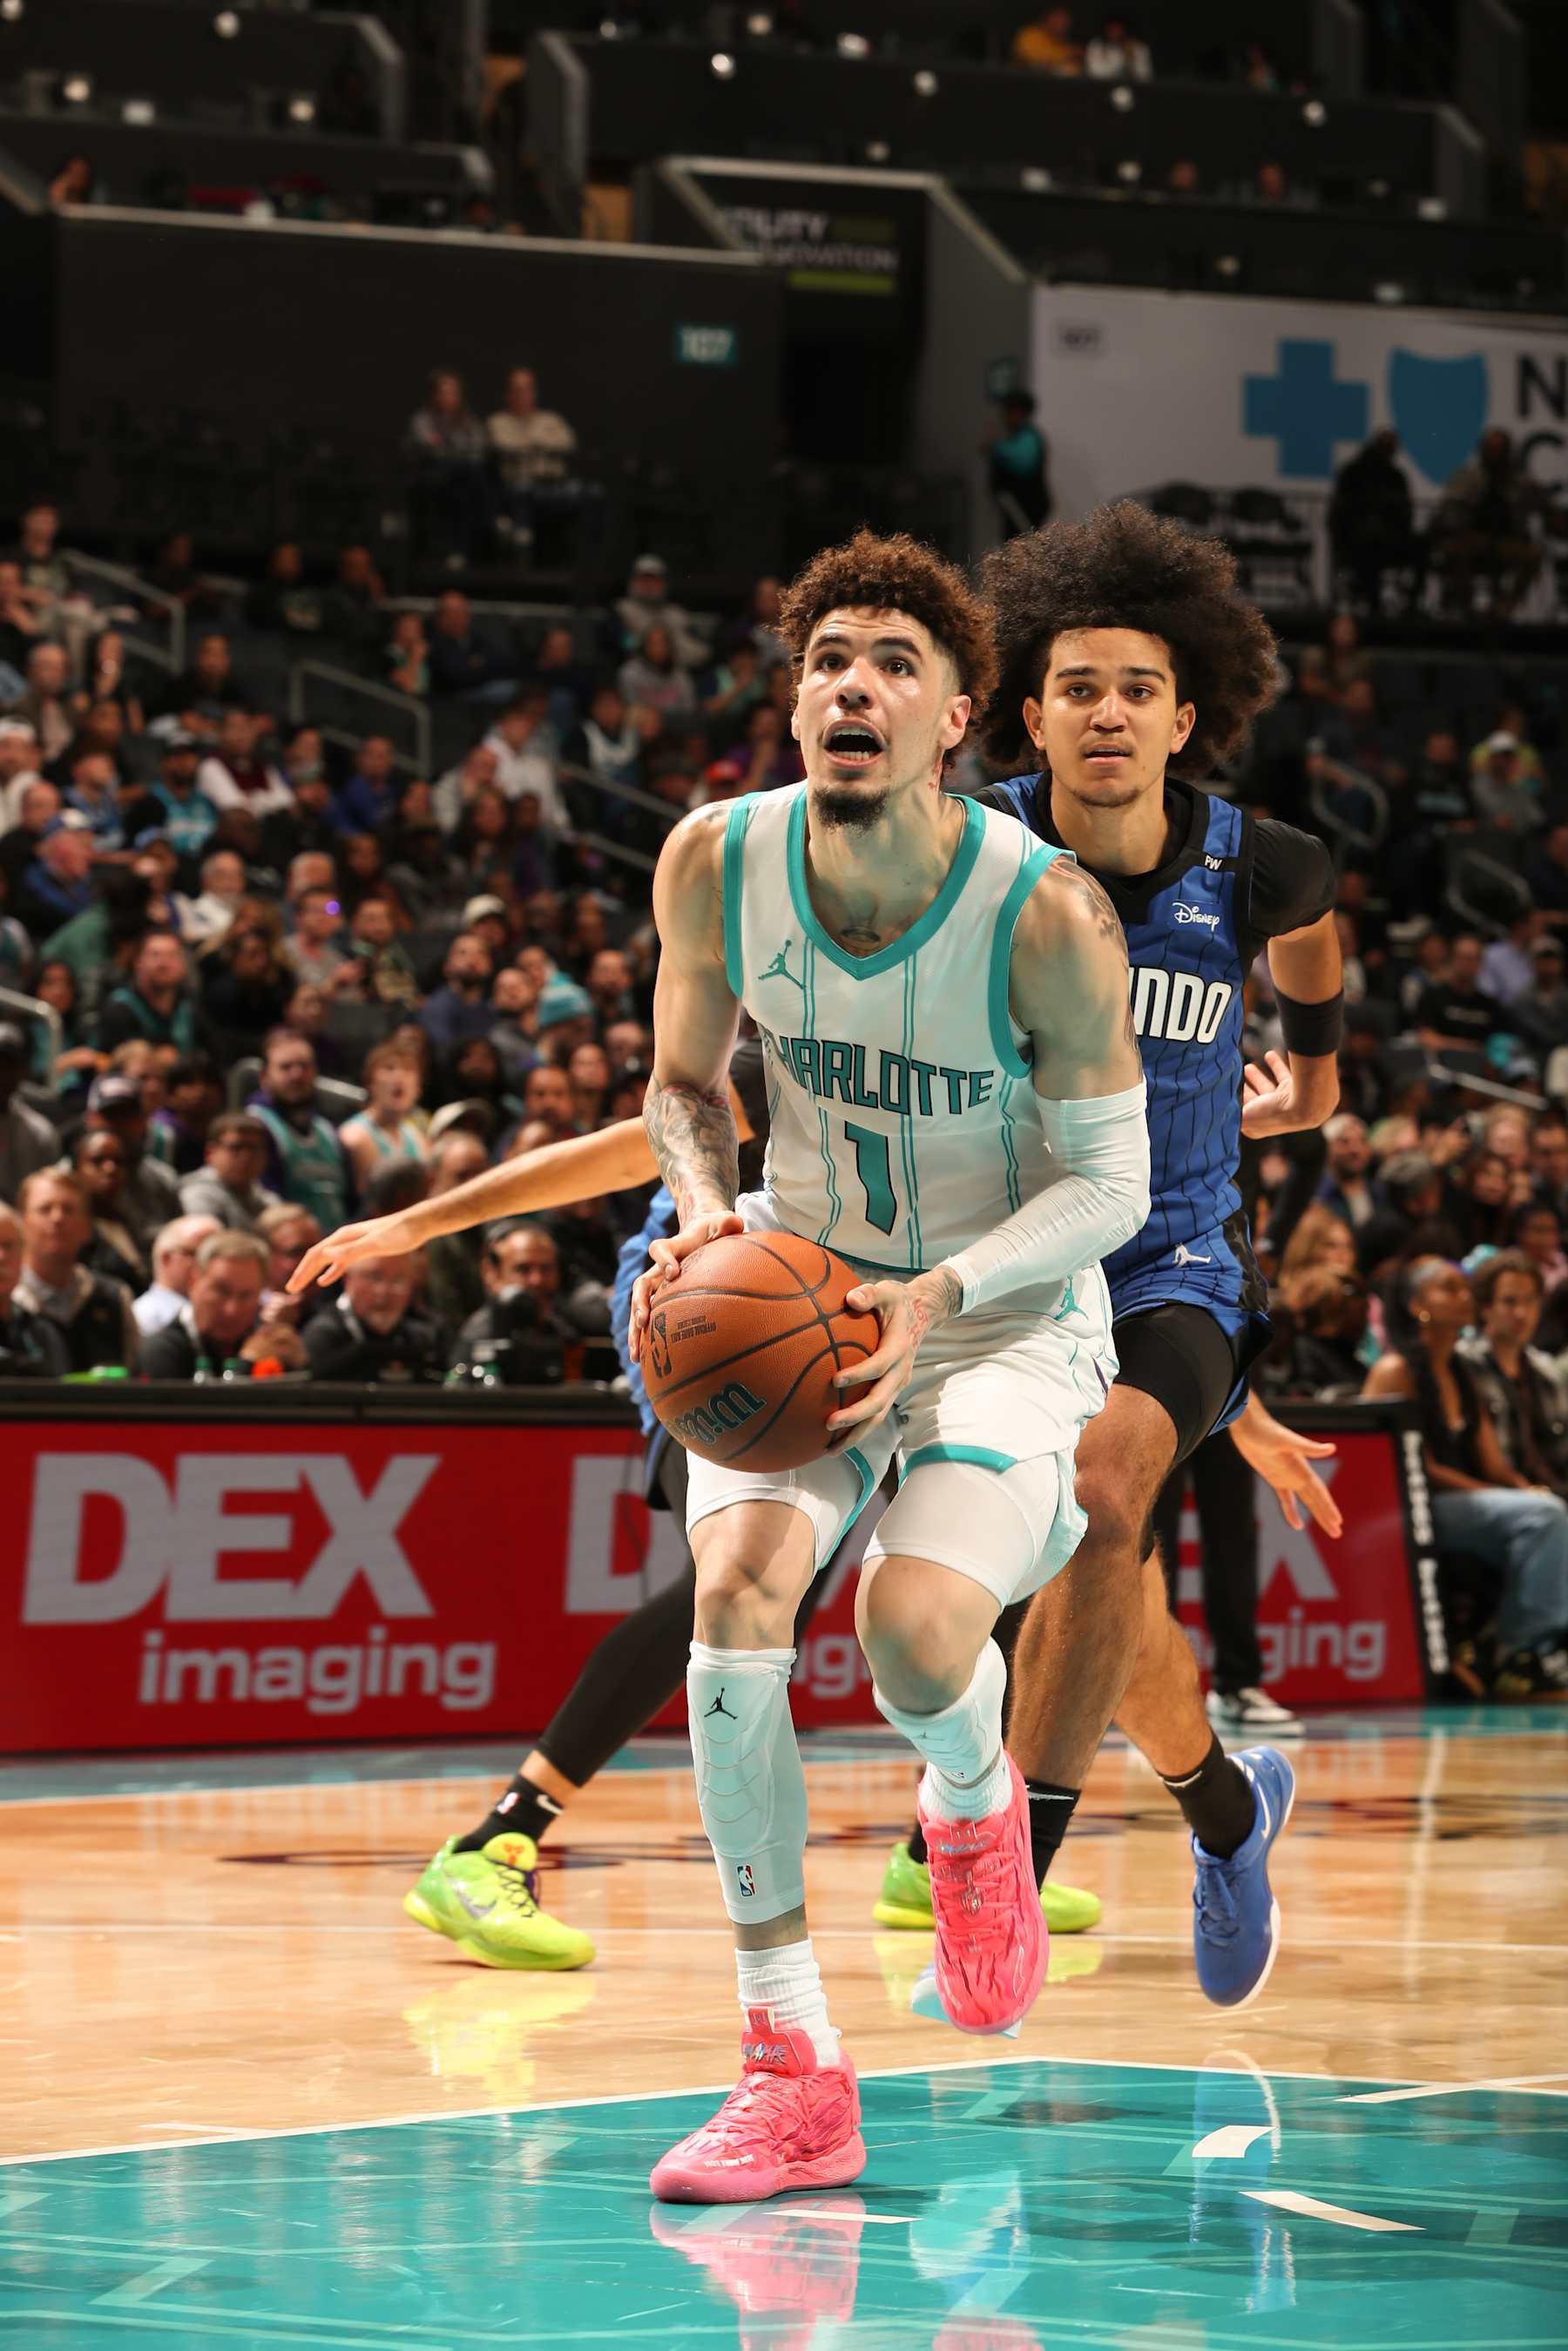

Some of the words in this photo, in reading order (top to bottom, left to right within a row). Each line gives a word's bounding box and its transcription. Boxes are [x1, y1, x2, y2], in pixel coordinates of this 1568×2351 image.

[1204, 855, 1223, 871] PW
[1172, 902, 1220, 932] Disney
[1129, 966, 1233, 1044] NDO
[770, 1031, 994, 1116] HARLOTTE
[844, 1120, 897, 1237] 1
[21, 1452, 443, 1625] DEX
[139, 1625, 497, 1714] imaging
